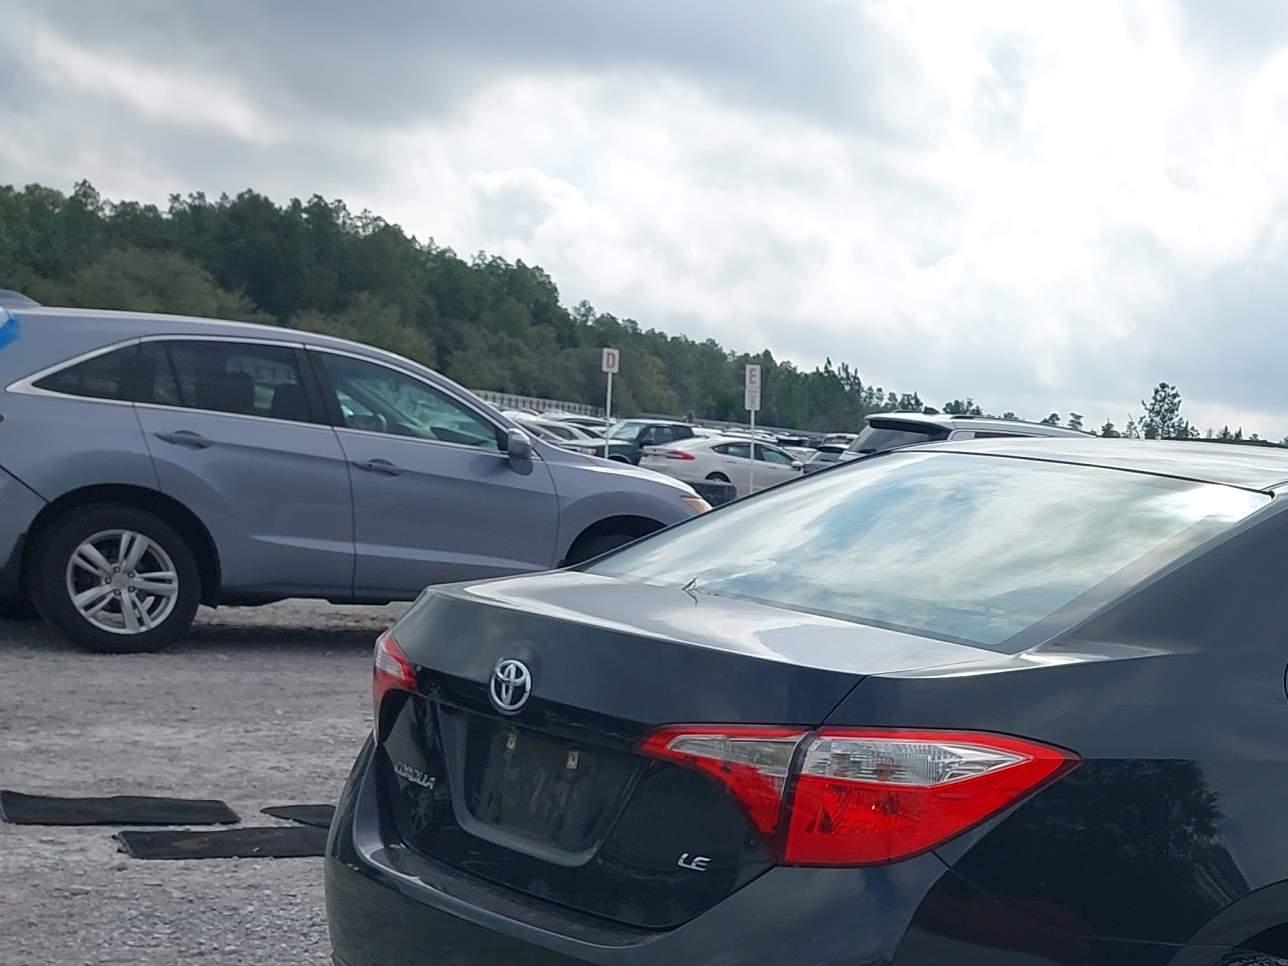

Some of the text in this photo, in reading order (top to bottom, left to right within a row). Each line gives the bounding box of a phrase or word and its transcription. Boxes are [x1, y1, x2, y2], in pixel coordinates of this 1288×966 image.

[606, 352, 616, 369] D
[749, 368, 757, 385] E
[677, 853, 712, 871] LE
